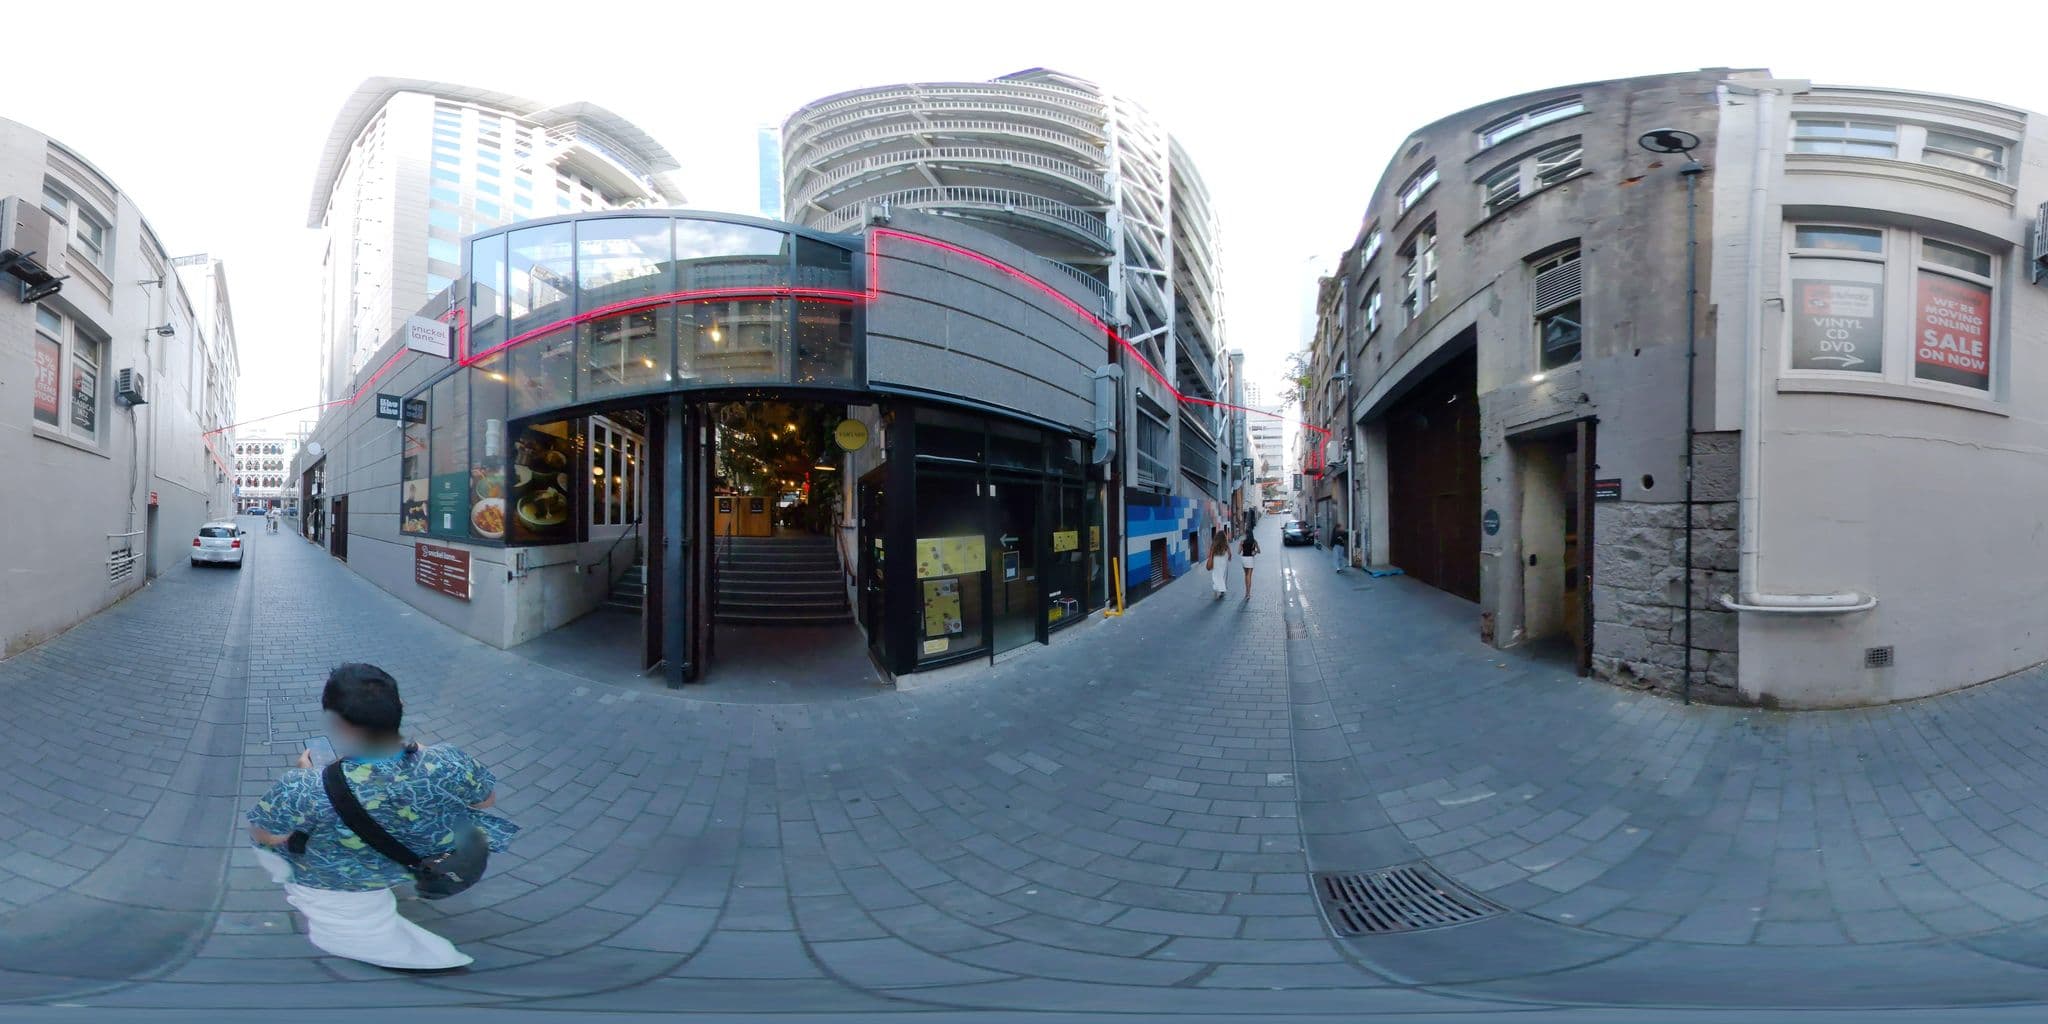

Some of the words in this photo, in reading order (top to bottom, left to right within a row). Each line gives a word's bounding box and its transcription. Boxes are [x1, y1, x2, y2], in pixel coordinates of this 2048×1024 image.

[1813, 317, 1864, 329] VINYL
[1925, 305, 1984, 326] MOVING
[1826, 328, 1850, 340] CD
[1820, 341, 1857, 353] DVD
[1923, 329, 1984, 359] SALE
[1919, 348, 1945, 362] ON
[1948, 353, 1986, 370] NOW
